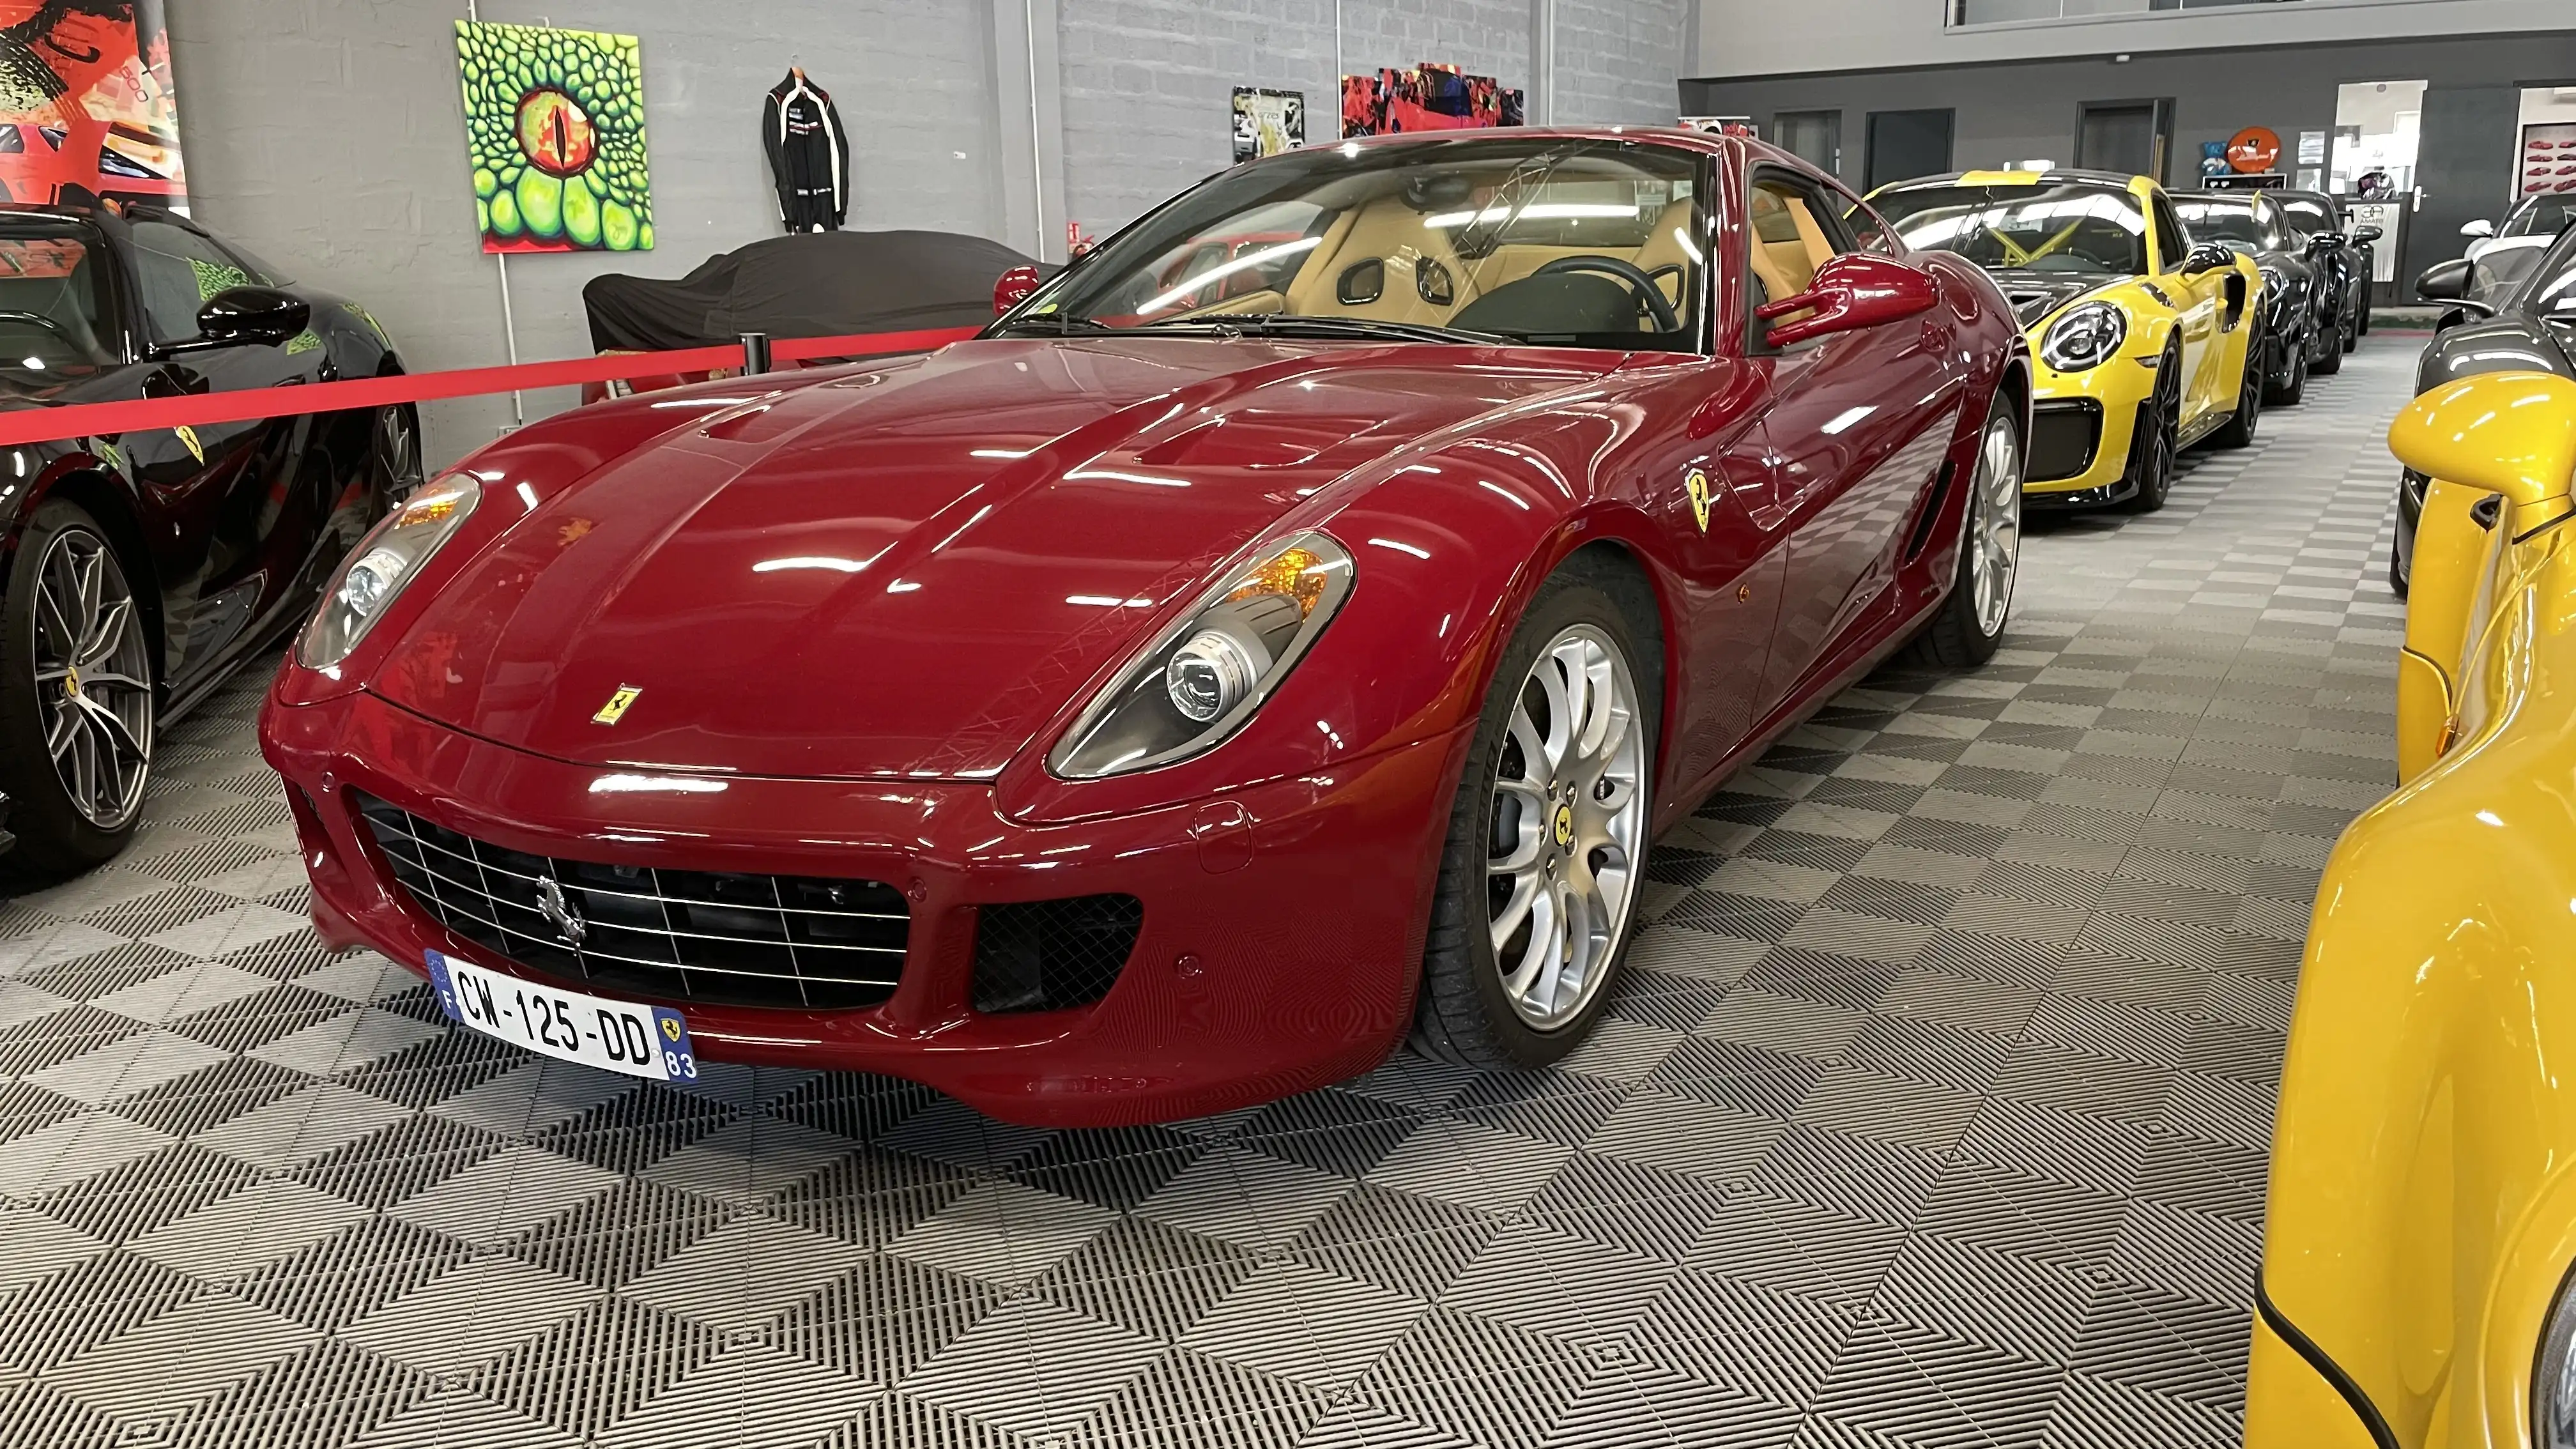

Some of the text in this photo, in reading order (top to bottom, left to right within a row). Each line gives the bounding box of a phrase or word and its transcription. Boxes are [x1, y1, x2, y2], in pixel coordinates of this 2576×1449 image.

[119, 66, 148, 102] 500
[442, 990, 452, 1008] F
[457, 971, 650, 1066] CW-125-DD
[665, 1051, 696, 1078] 83
